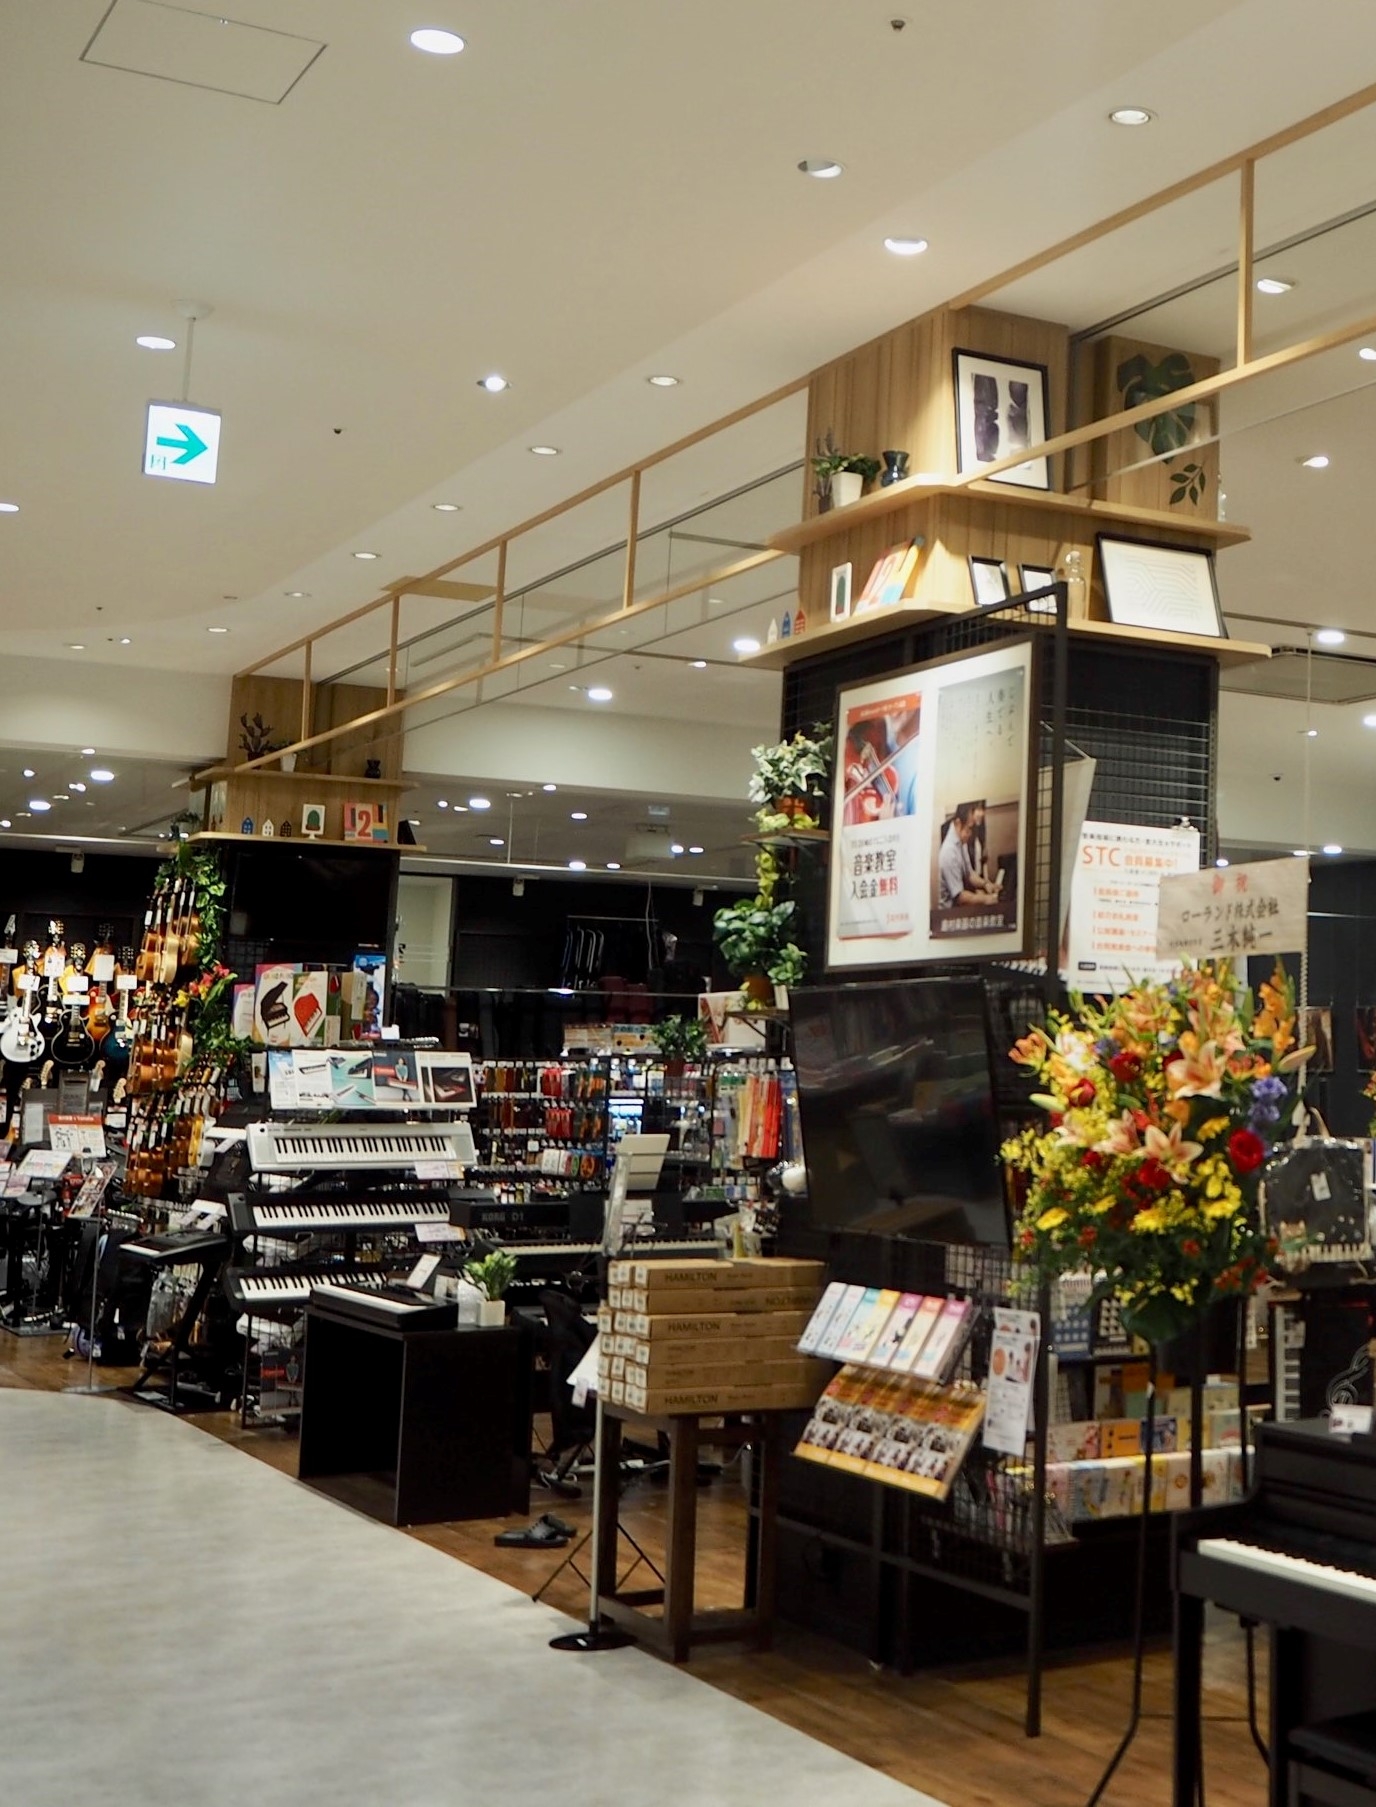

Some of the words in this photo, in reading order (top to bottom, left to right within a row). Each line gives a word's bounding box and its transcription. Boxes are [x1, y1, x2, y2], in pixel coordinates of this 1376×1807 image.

[853, 849, 896, 877] 音楽教室
[1082, 845, 1121, 867] STC
[851, 876, 898, 900] 入会金無料
[1181, 896, 1280, 924] ローランド株式会社
[665, 1273, 717, 1282] HAMILTON
[668, 1322, 720, 1332] HAMILTON
[664, 1394, 718, 1405] HAMILTON
